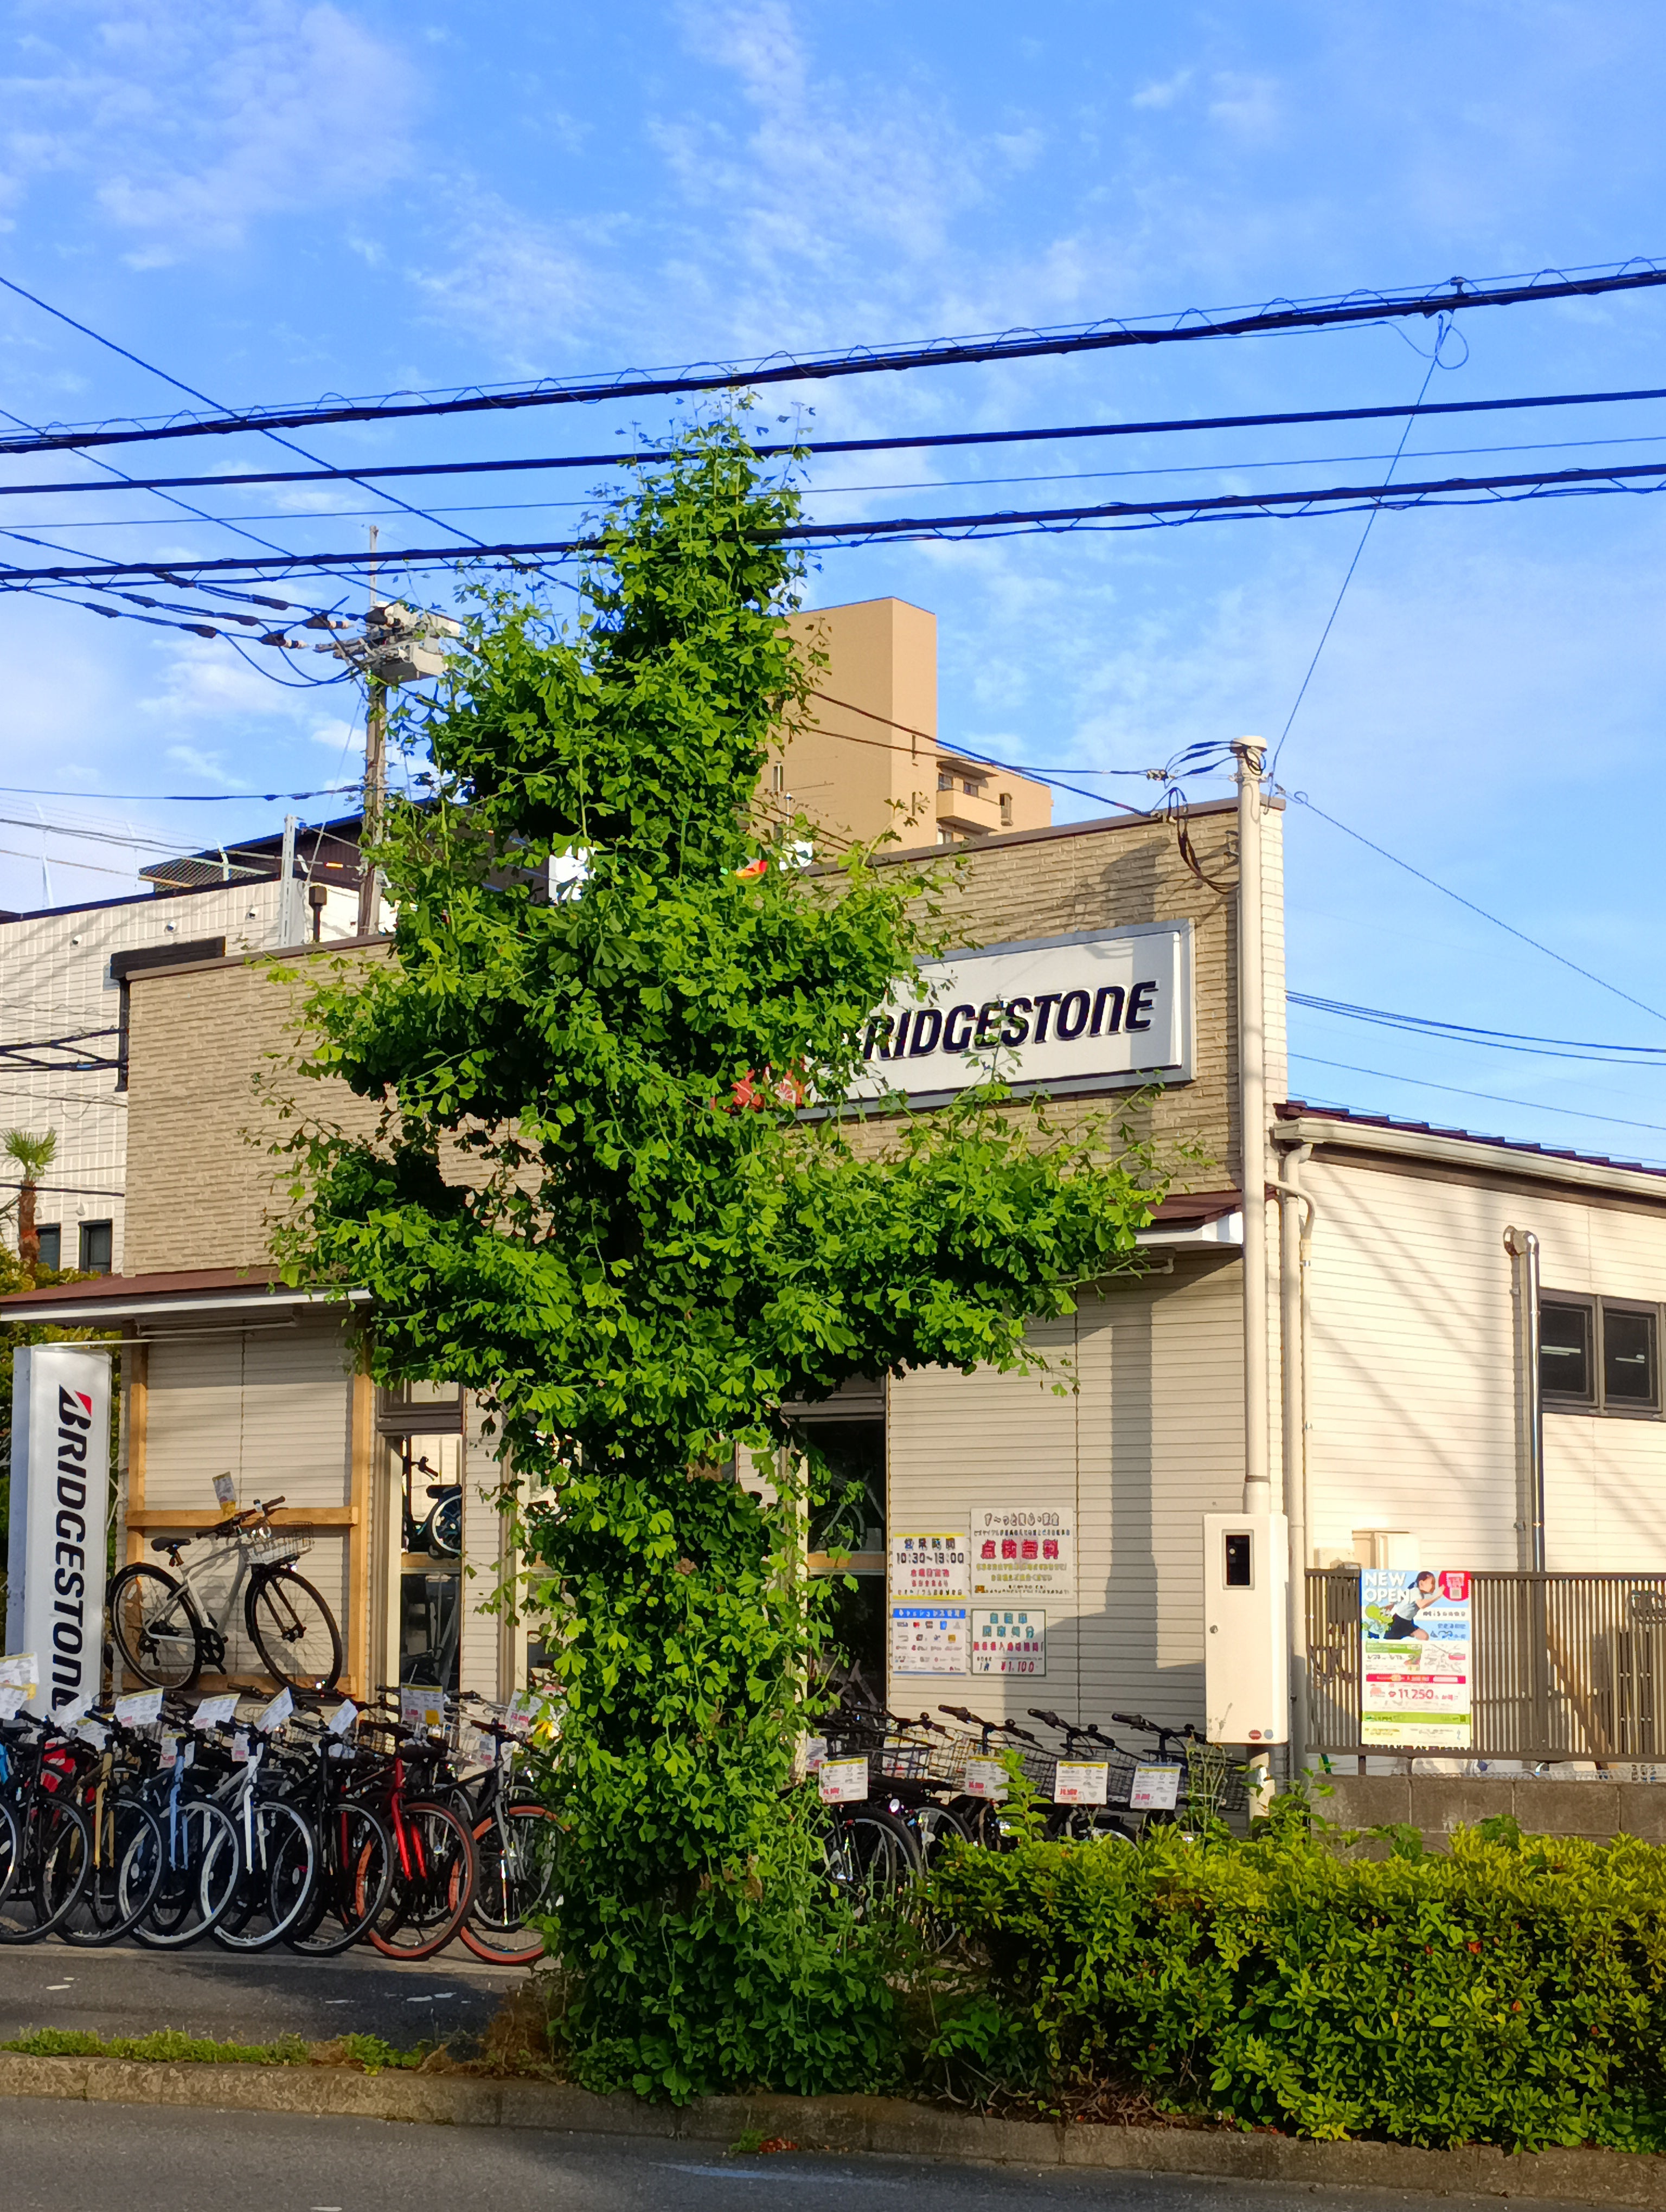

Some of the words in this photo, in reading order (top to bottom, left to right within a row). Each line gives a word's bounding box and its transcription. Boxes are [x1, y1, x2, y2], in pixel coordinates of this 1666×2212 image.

[863, 979, 1159, 1060] RIDGESTONE
[1365, 1572, 1405, 1587] NEW
[1364, 1587, 1409, 1603] OPEN
